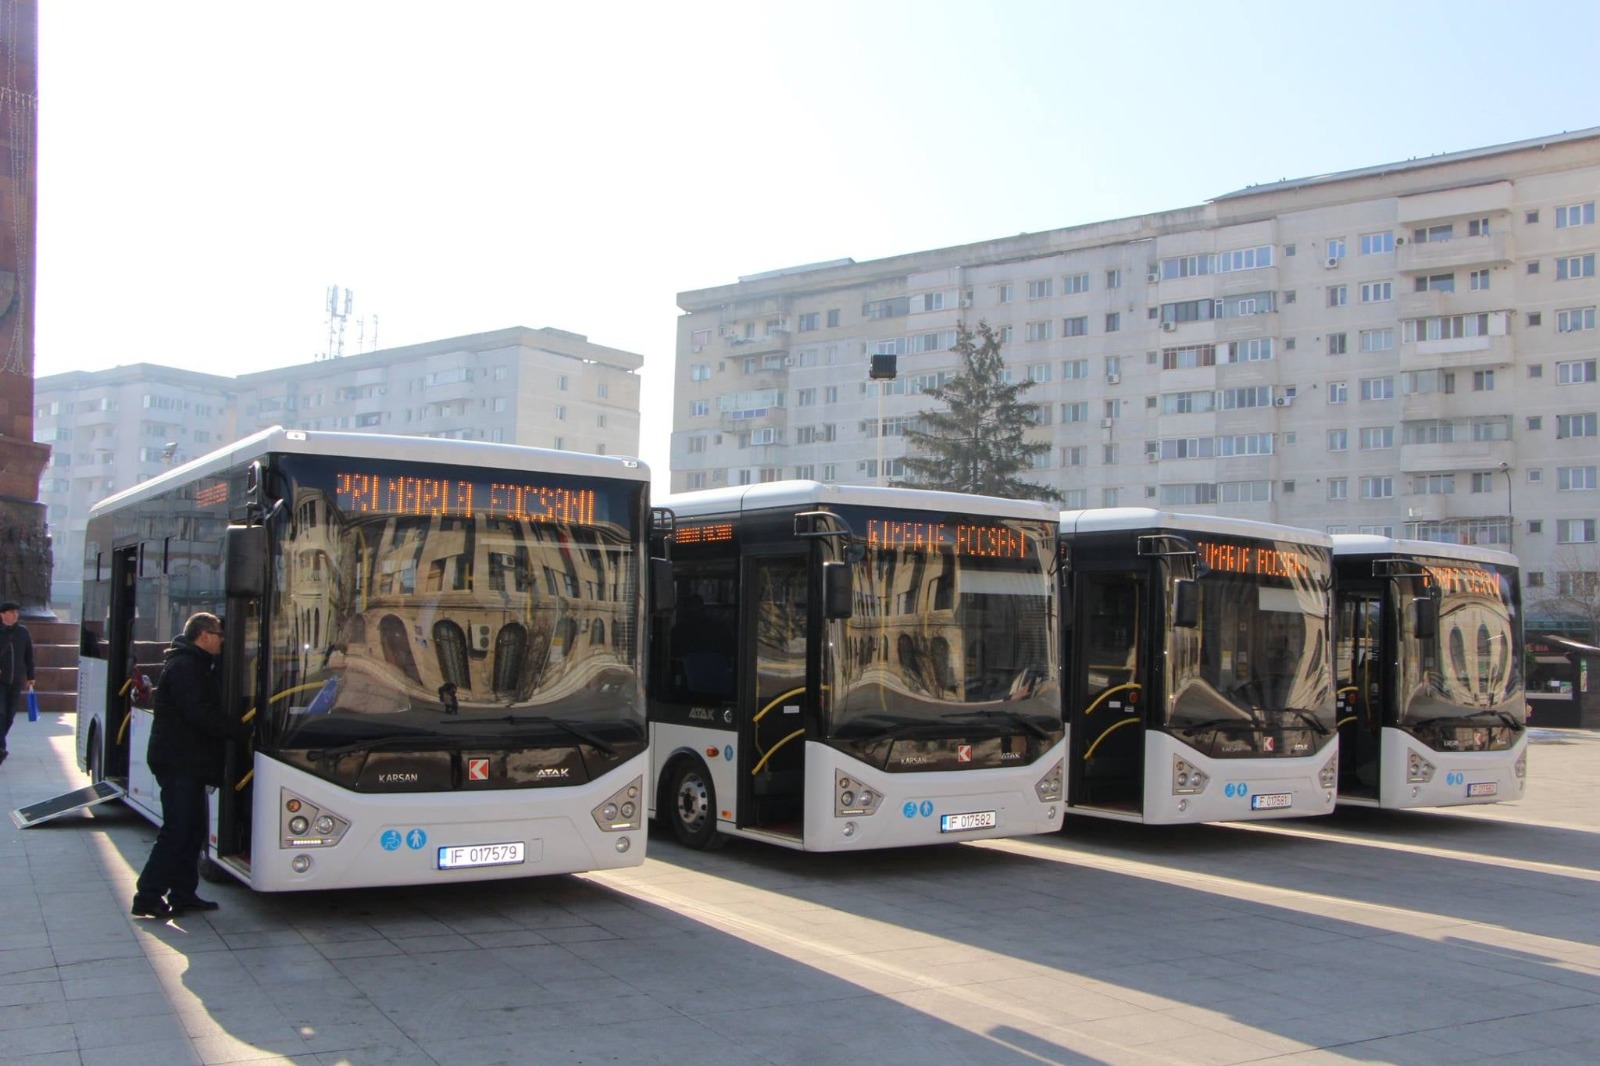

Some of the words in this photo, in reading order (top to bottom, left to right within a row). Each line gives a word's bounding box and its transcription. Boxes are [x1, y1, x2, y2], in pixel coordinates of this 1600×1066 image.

[490, 483, 594, 525] FOCSANI
[689, 707, 715, 720] ATAK
[378, 773, 418, 783] KARSAN
[536, 767, 570, 778] ATAK
[961, 814, 991, 827] 017582
[450, 849, 465, 864] IF
[470, 845, 517, 863] 017579
